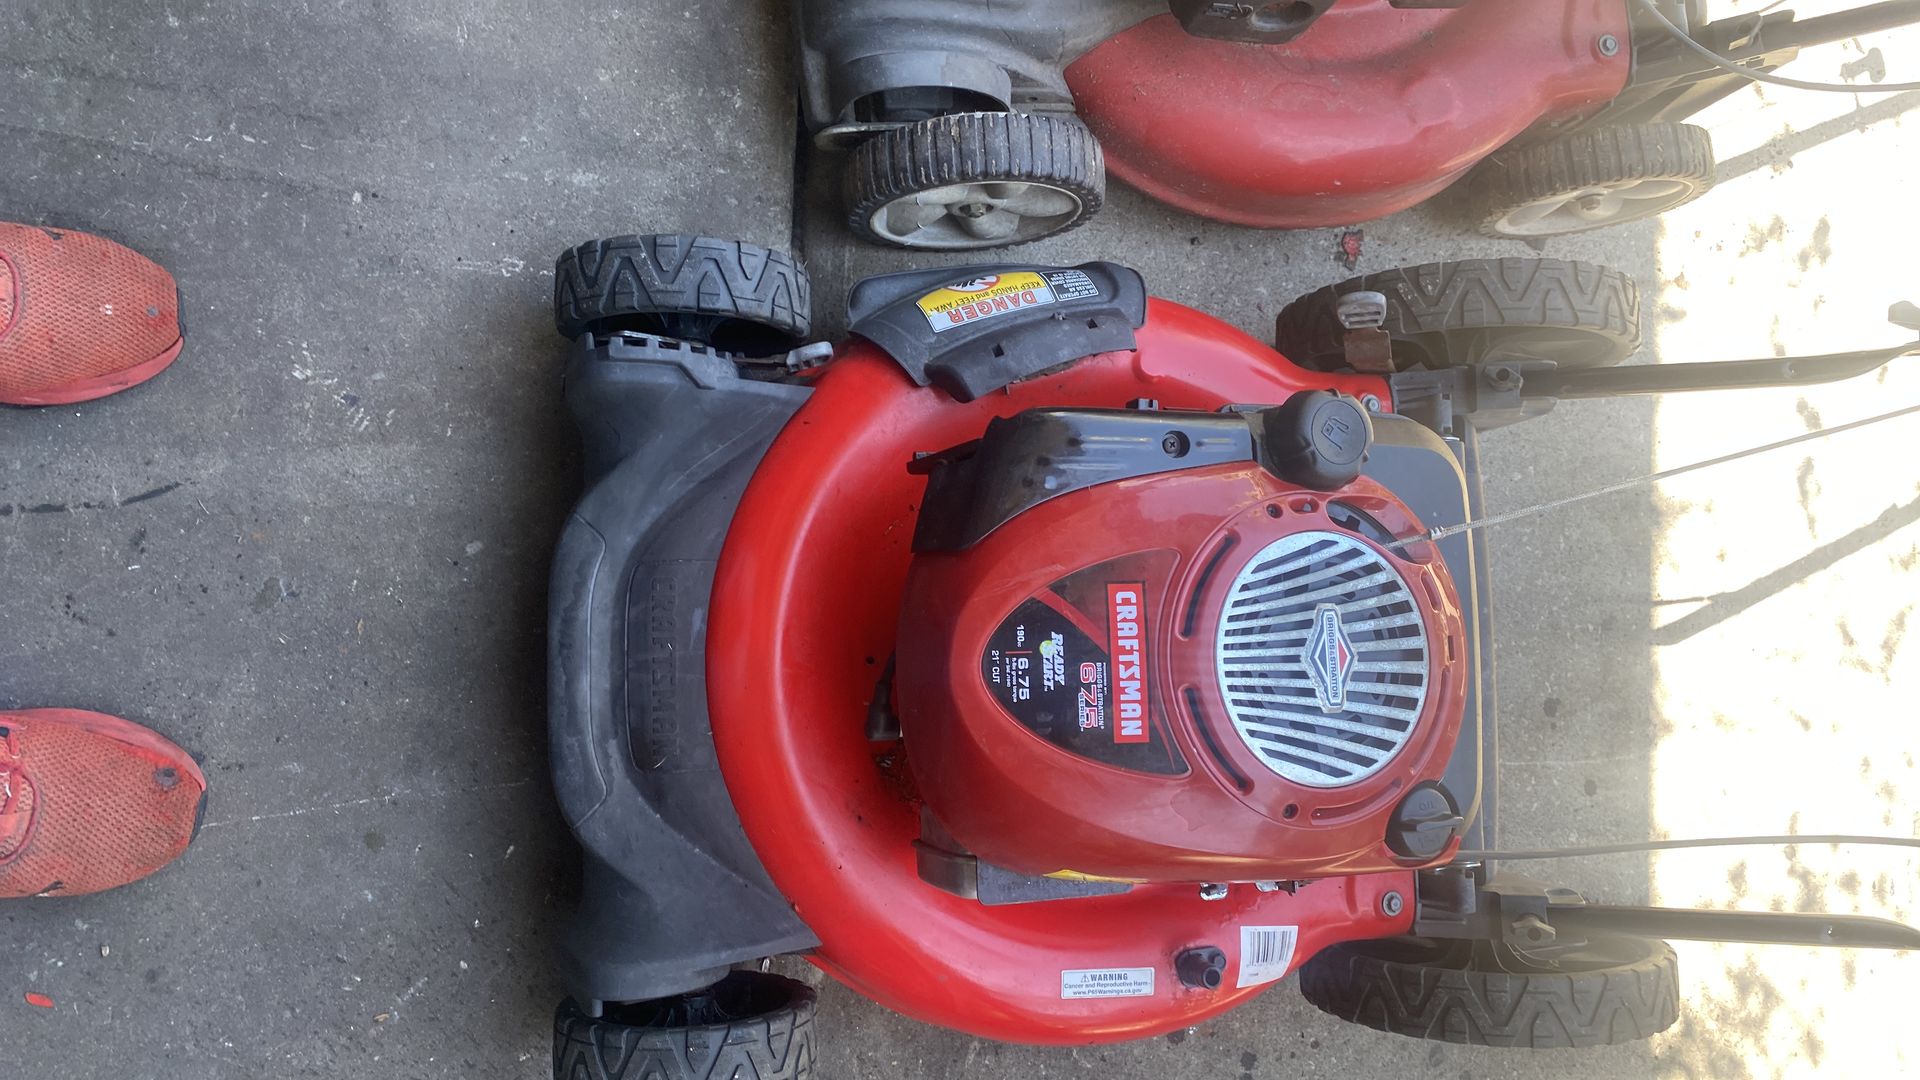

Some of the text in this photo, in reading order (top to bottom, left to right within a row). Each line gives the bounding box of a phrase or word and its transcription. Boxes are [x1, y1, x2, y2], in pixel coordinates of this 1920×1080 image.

[990, 284, 1018, 296] HANDS
[1020, 281, 1040, 290] KEEP
[955, 295, 974, 305] FEET
[976, 291, 990, 300] and
[946, 290, 1037, 324] DANGER
[652, 577, 680, 758] CRAFTSMAN
[1052, 632, 1065, 686] READY
[1116, 591, 1142, 736] CRAFTSMAN
[992, 666, 1000, 684] CUT
[1018, 658, 1030, 700] 6.75
[1080, 662, 1098, 728] 675
[1090, 973, 1128, 982] WARNING
[1096, 980, 1132, 988] Reproductive
